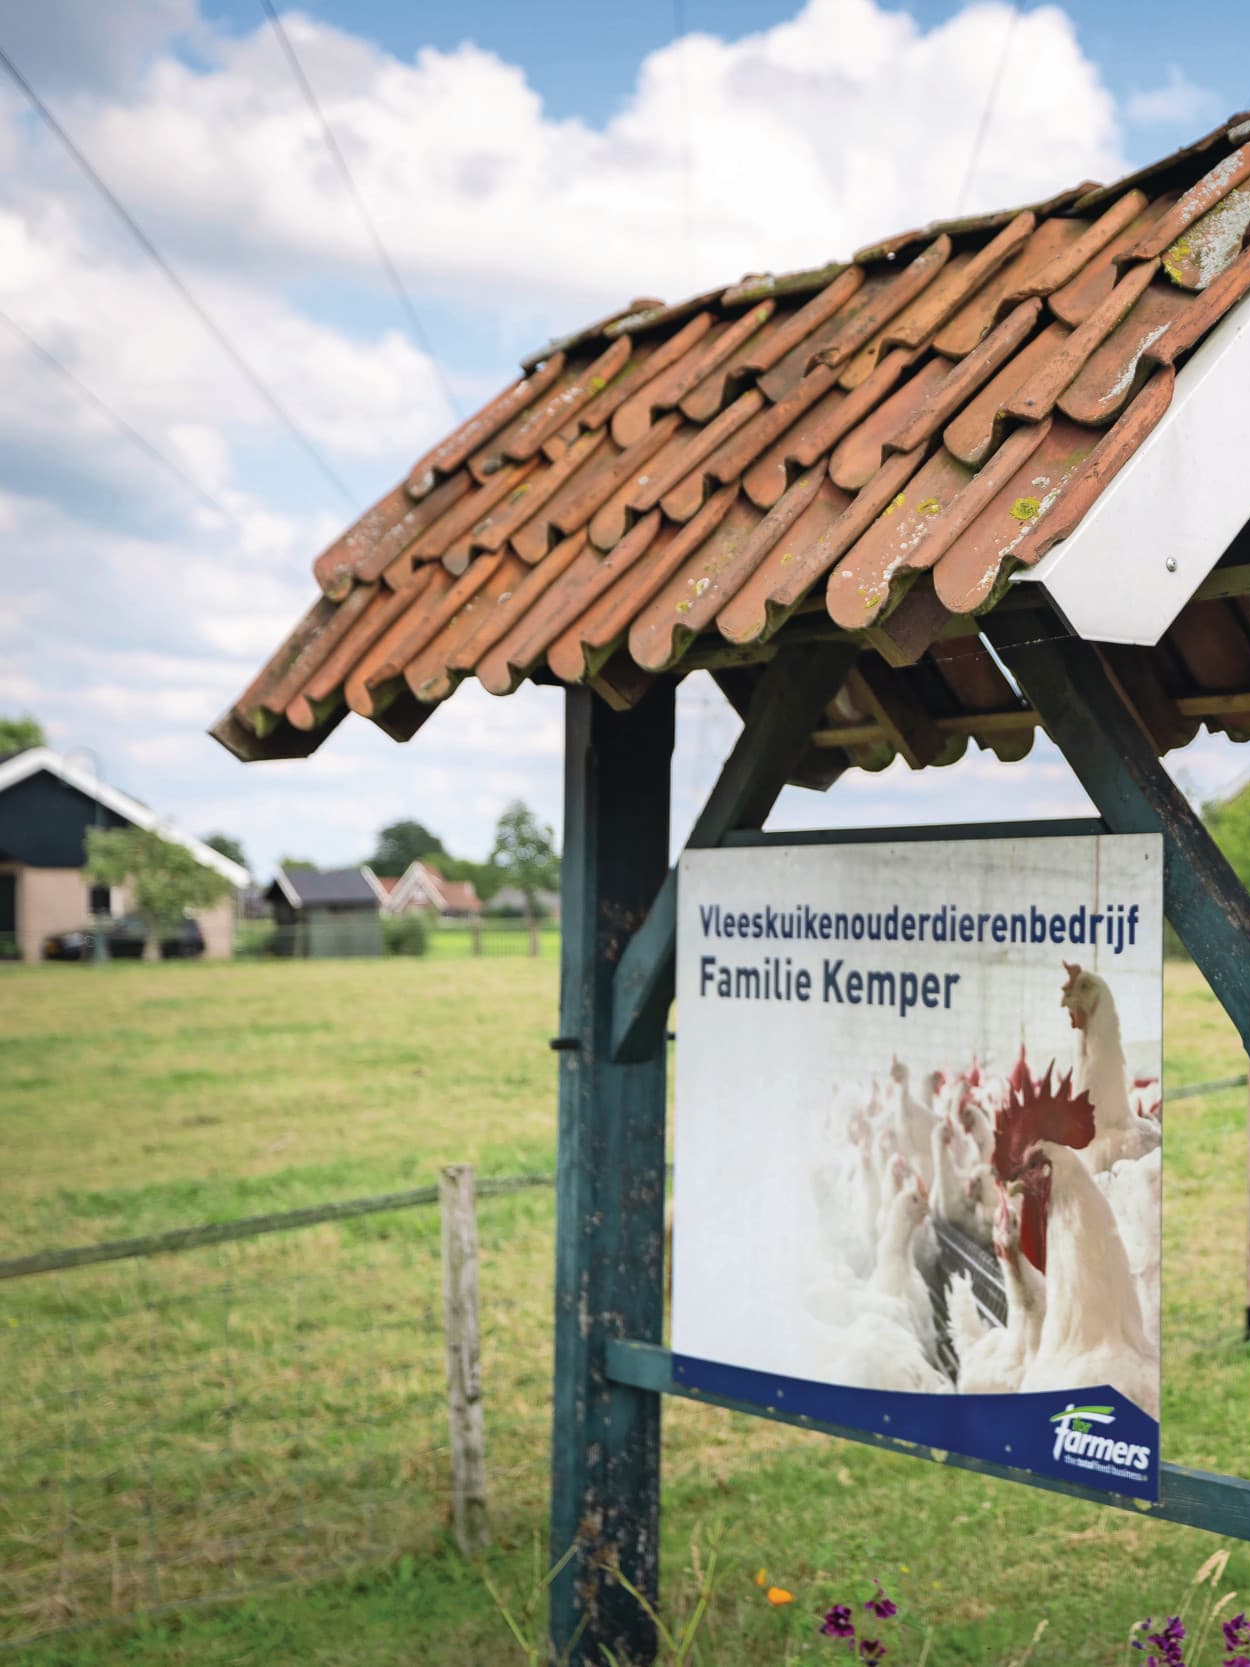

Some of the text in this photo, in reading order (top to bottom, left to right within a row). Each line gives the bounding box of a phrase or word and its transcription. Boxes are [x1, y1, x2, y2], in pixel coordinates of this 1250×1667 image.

[700, 904, 1139, 954] Vleeskuikenouderdierenbedrijf
[700, 956, 960, 1016] Familie Kemper
[1053, 1404, 1151, 1470] farmers
